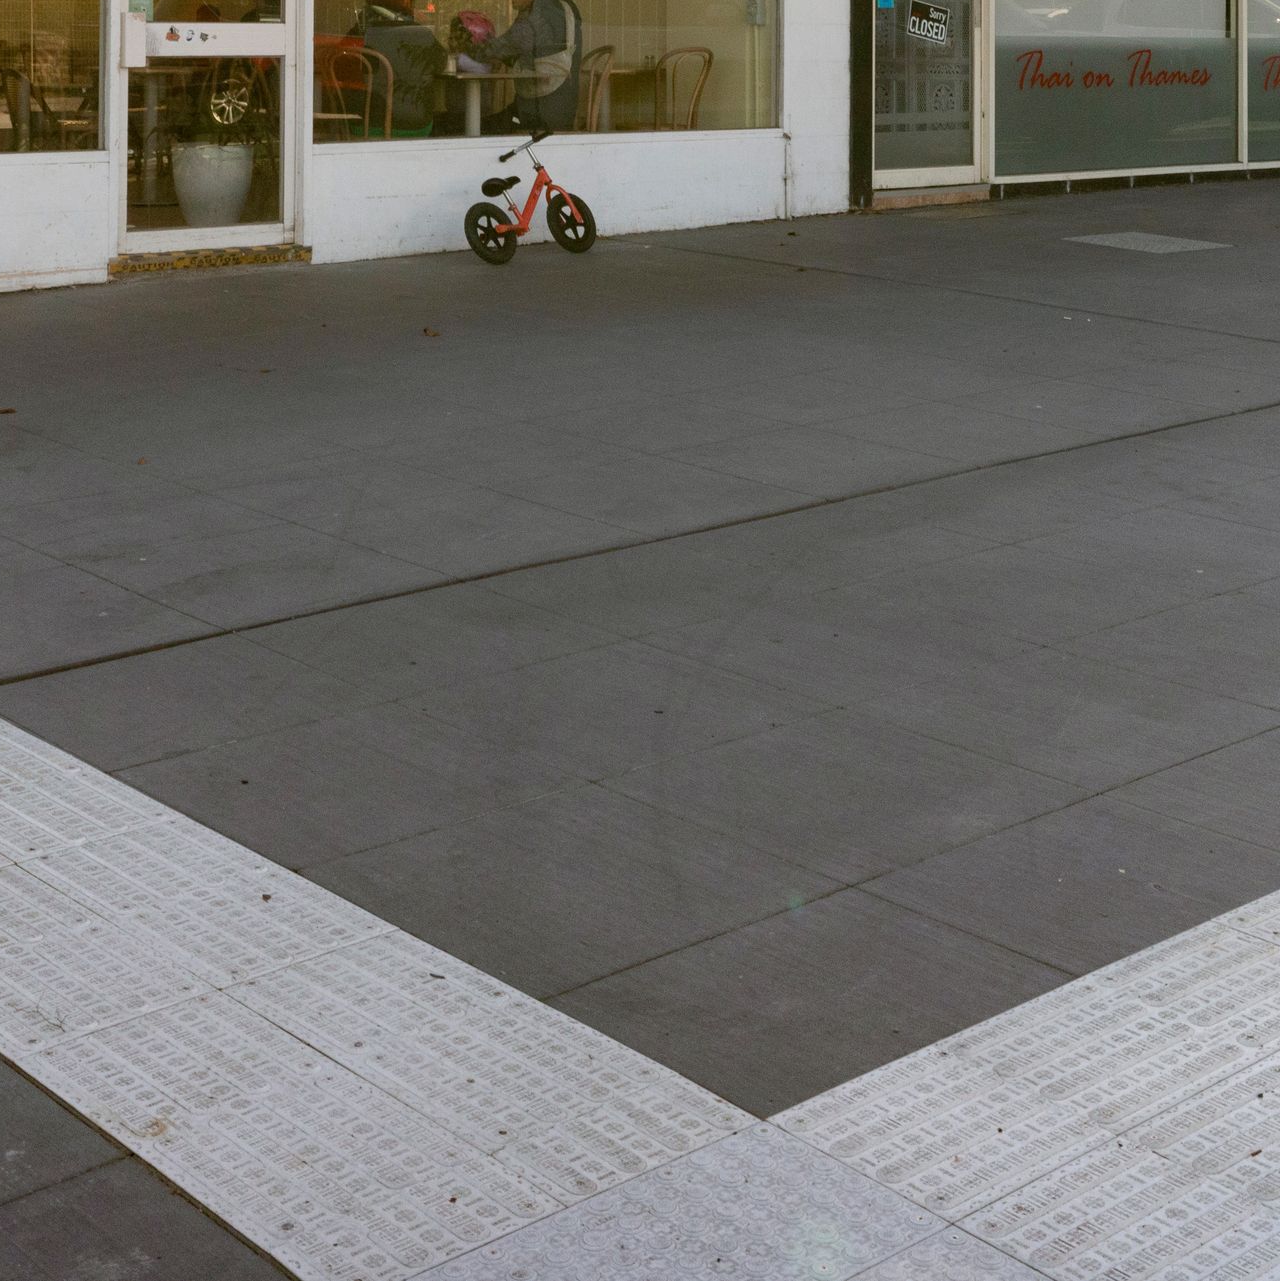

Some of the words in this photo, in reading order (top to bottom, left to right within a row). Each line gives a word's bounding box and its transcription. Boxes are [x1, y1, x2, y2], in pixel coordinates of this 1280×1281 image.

[929, 8, 946, 23] Sorry
[909, 16, 946, 41] CLOSED
[1016, 49, 1074, 90] Thai
[1082, 66, 1114, 88] on
[1127, 49, 1211, 89] Thames
